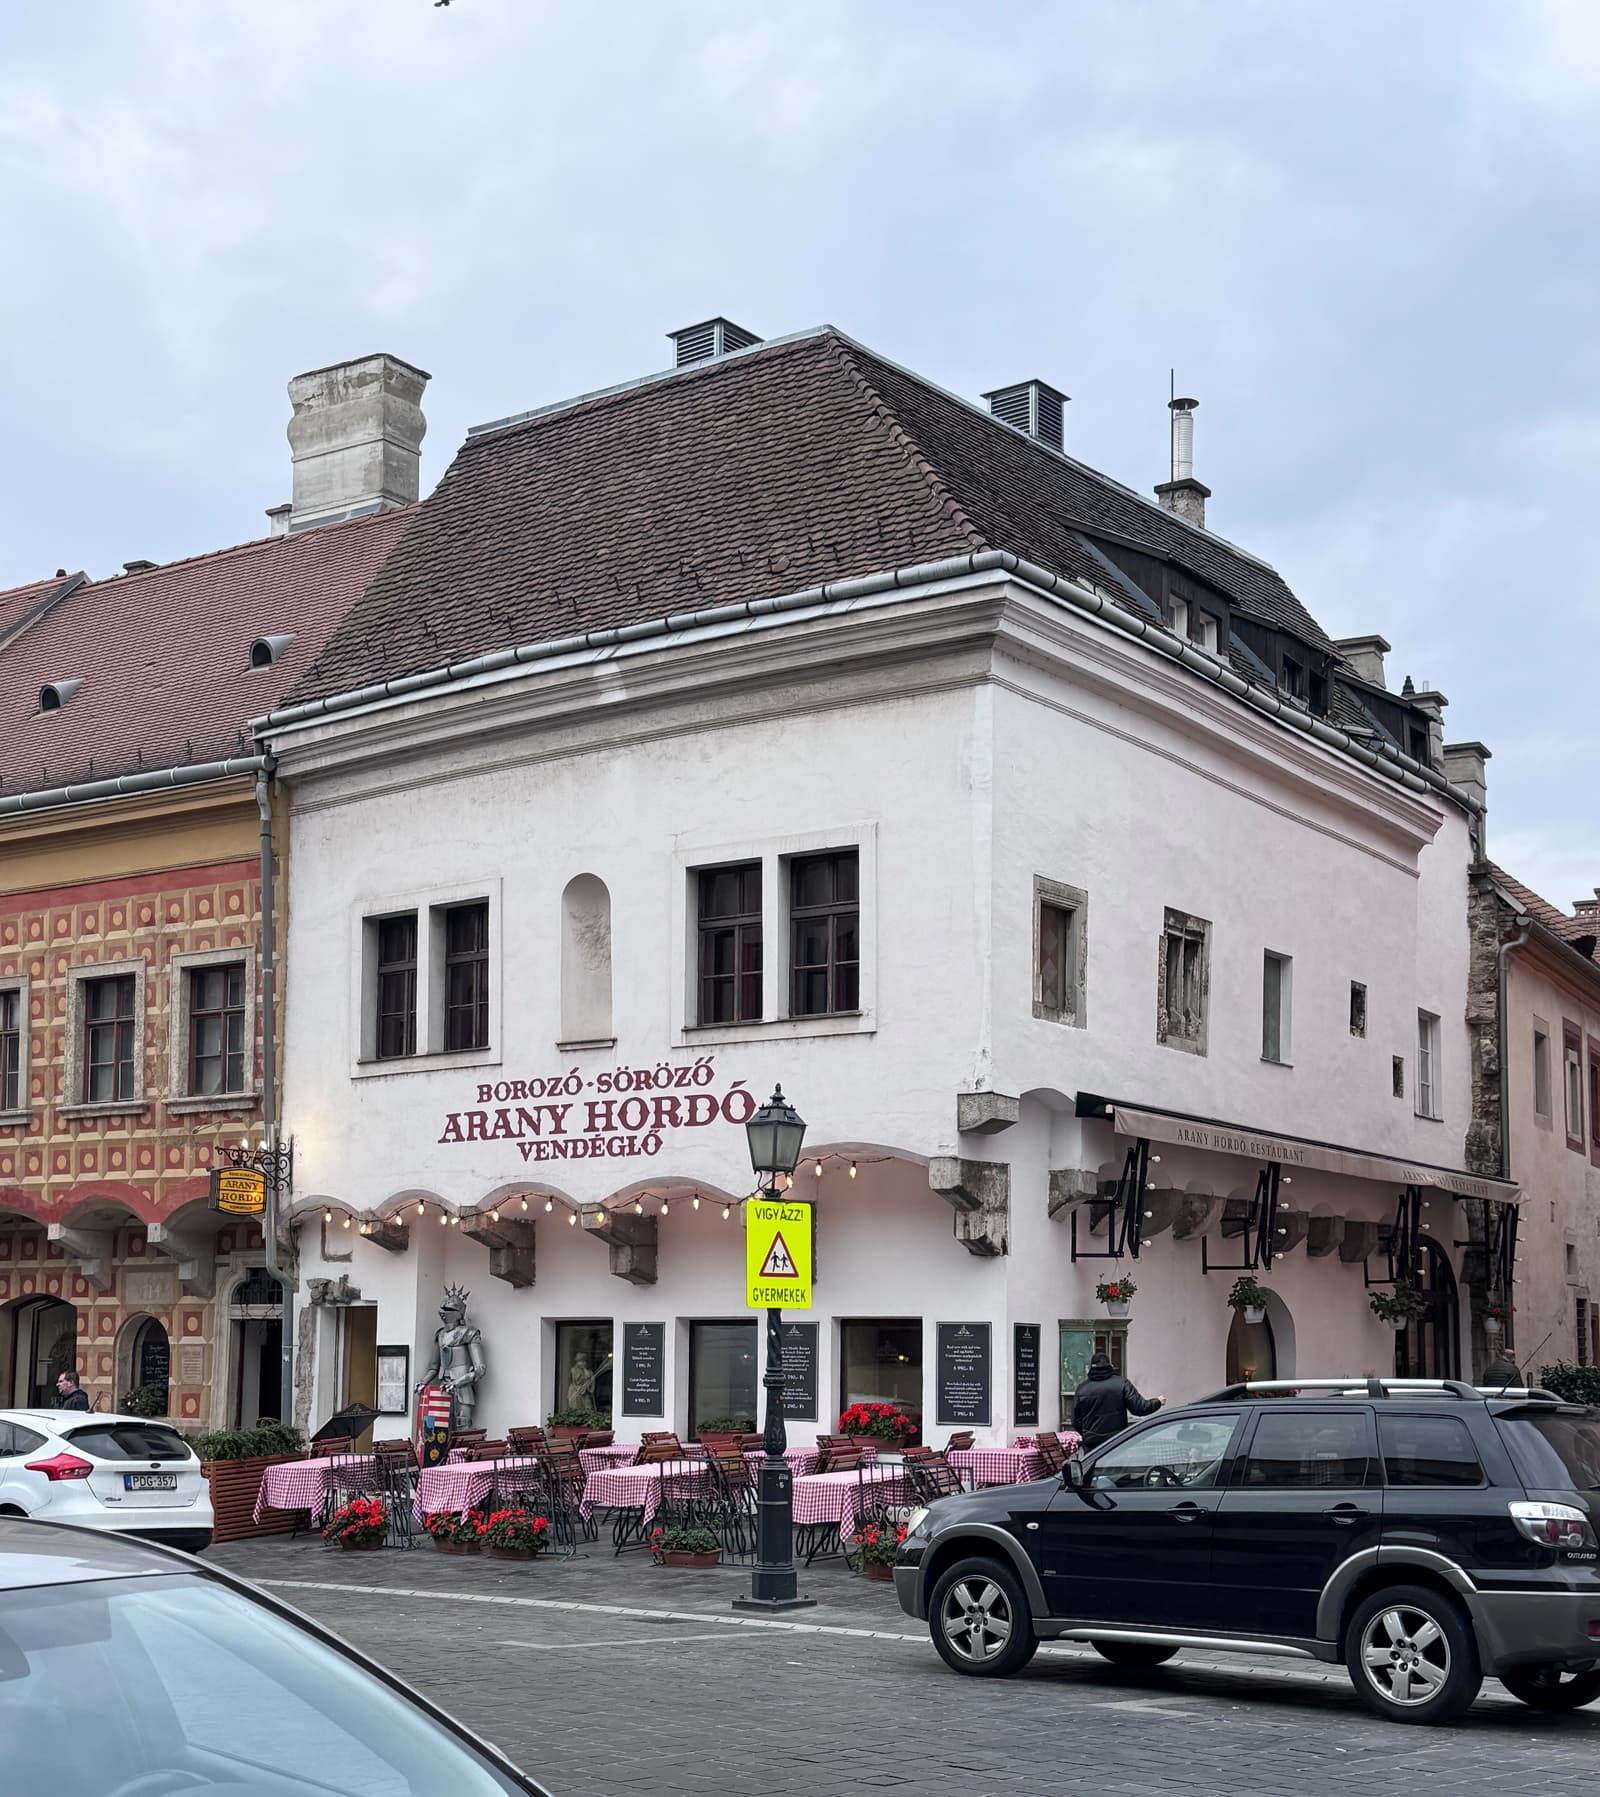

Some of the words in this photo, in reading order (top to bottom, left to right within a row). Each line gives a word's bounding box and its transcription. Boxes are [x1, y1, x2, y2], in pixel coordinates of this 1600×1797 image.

[438, 1103, 573, 1144] ARANY
[583, 1080, 756, 1133] HORDÓ
[516, 1129, 664, 1162] VENDÉGLŐ
[1177, 1128, 1209, 1145] ARANY
[1214, 1135, 1246, 1153] HORDÓ
[1250, 1142, 1305, 1162] RESTAURANT
[224, 1180, 258, 1190] ARANY
[753, 1287, 806, 1303] GYERMEKEK
[132, 1475, 174, 1487] PDG-357
